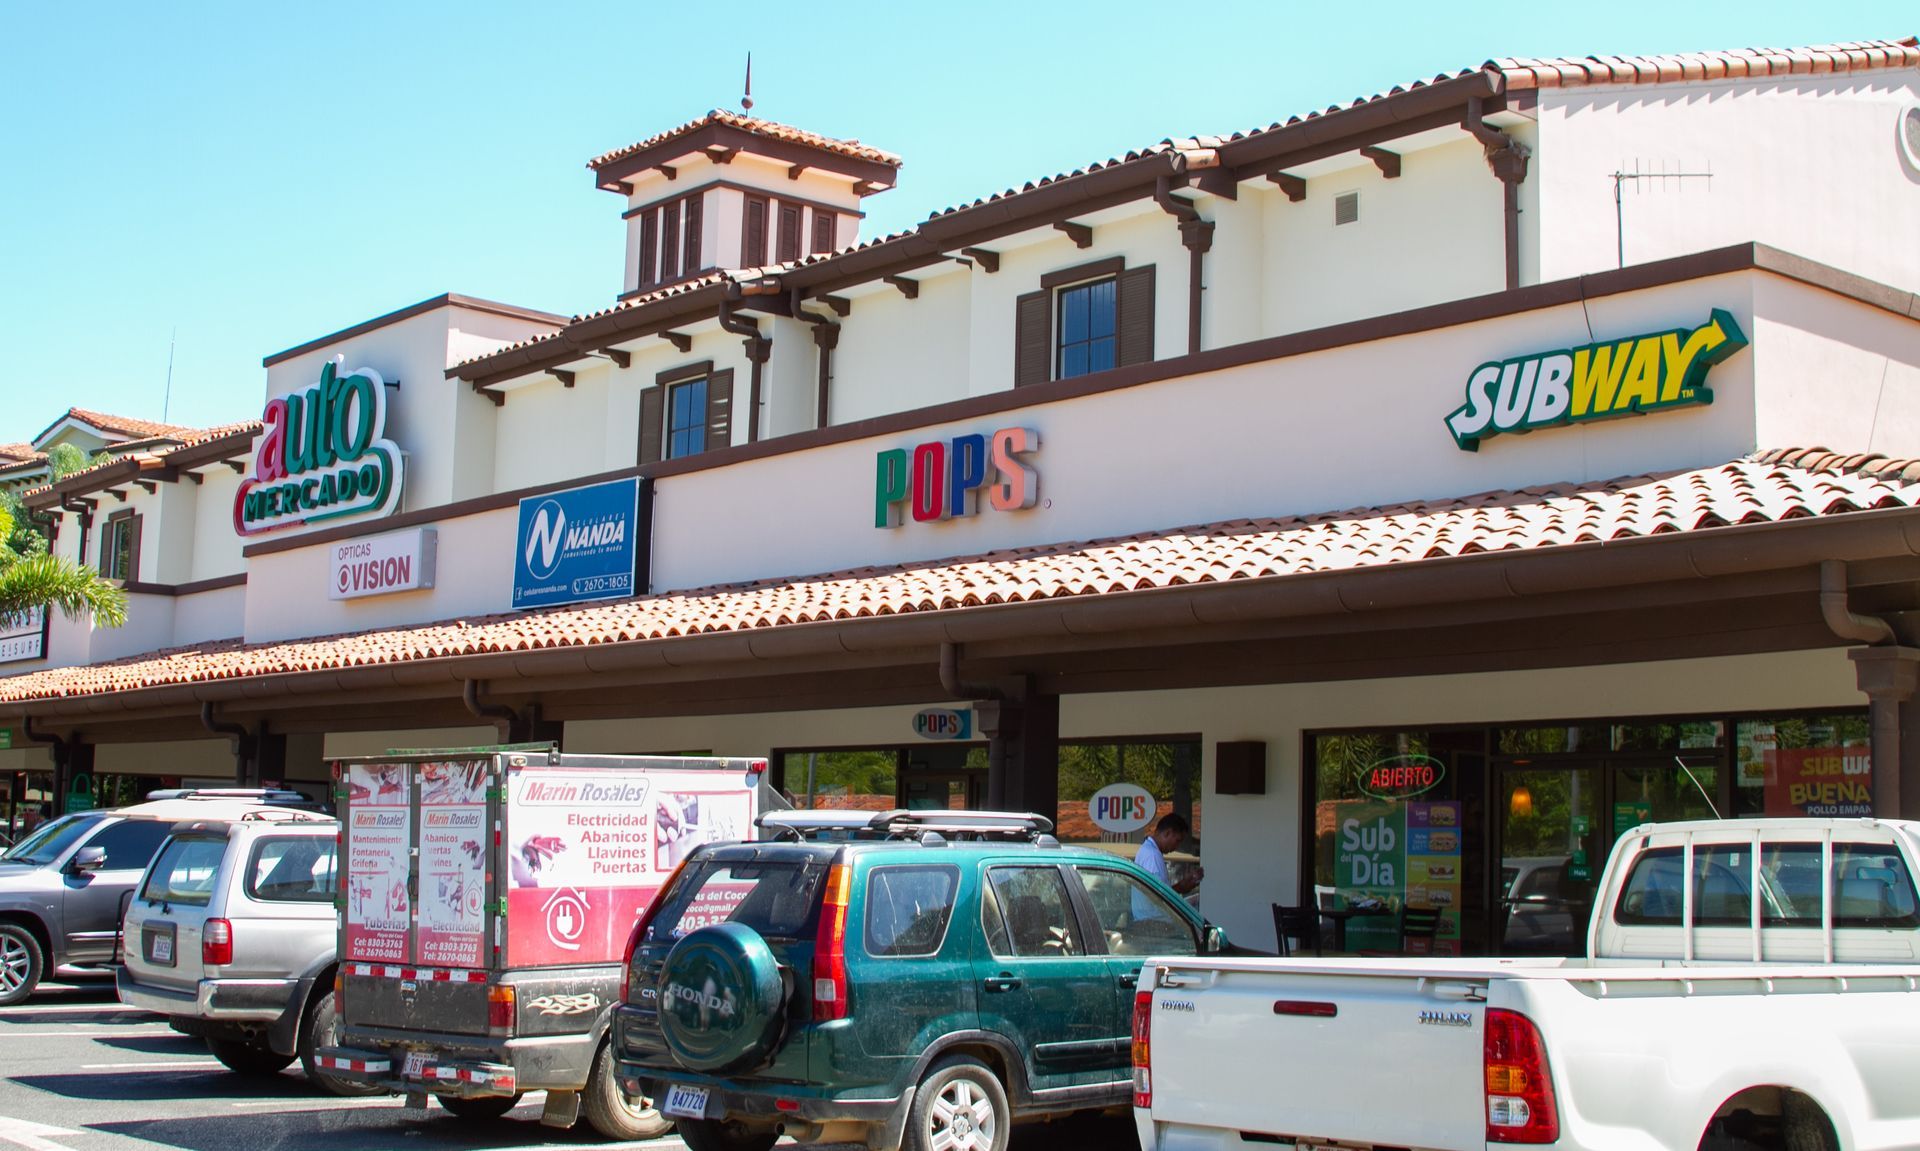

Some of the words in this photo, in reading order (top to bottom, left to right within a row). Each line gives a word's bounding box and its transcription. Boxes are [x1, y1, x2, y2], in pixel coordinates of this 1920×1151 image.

[1449, 318, 1728, 440] SUBWAY
[255, 360, 378, 483] auto
[875, 426, 1038, 529] POPS
[244, 464, 380, 523] MERCADO
[564, 519, 625, 551] NANDA
[338, 543, 371, 560] OPTICAS
[352, 555, 411, 592] VISION
[584, 575, 629, 592] 2670-1805
[918, 714, 958, 733] POPS
[1801, 756, 1870, 777] SUBW
[1369, 766, 1434, 788] ABIERTO
[579, 782, 644, 801] Rosales
[1097, 795, 1146, 820] POPS
[1807, 805, 1837, 815] POLLO
[1839, 805, 1871, 815] EMPAN
[376, 811, 405, 826] Rosales
[450, 810, 478, 825] Rosales
[567, 813, 648, 826] Electricidad
[424, 834, 459, 843] Abanicos
[580, 830, 648, 843] Abanicos
[1342, 817, 1396, 852] Sub
[429, 847, 452, 855] uertas
[587, 846, 647, 859] Llavines
[1340, 852, 1351, 863] del
[592, 861, 647, 873] Puertas
[1352, 853, 1395, 886] Día
[706, 891, 722, 901] del
[432, 920, 480, 932] Electricidad
[354, 938, 367, 947] Cel:
[367, 938, 403, 949] 8303-3763
[424, 941, 438, 950] Cel:
[438, 942, 477, 952] 8303-3763
[353, 947, 365, 956] Tel:
[365, 948, 402, 958] 2670-0863
[423, 951, 437, 960] Tel:
[437, 952, 476, 963] 2670-0863
[669, 981, 735, 1016] HONDA
[1160, 999, 1195, 1012] TOYOTA
[1417, 1010, 1473, 1027] HILUX
